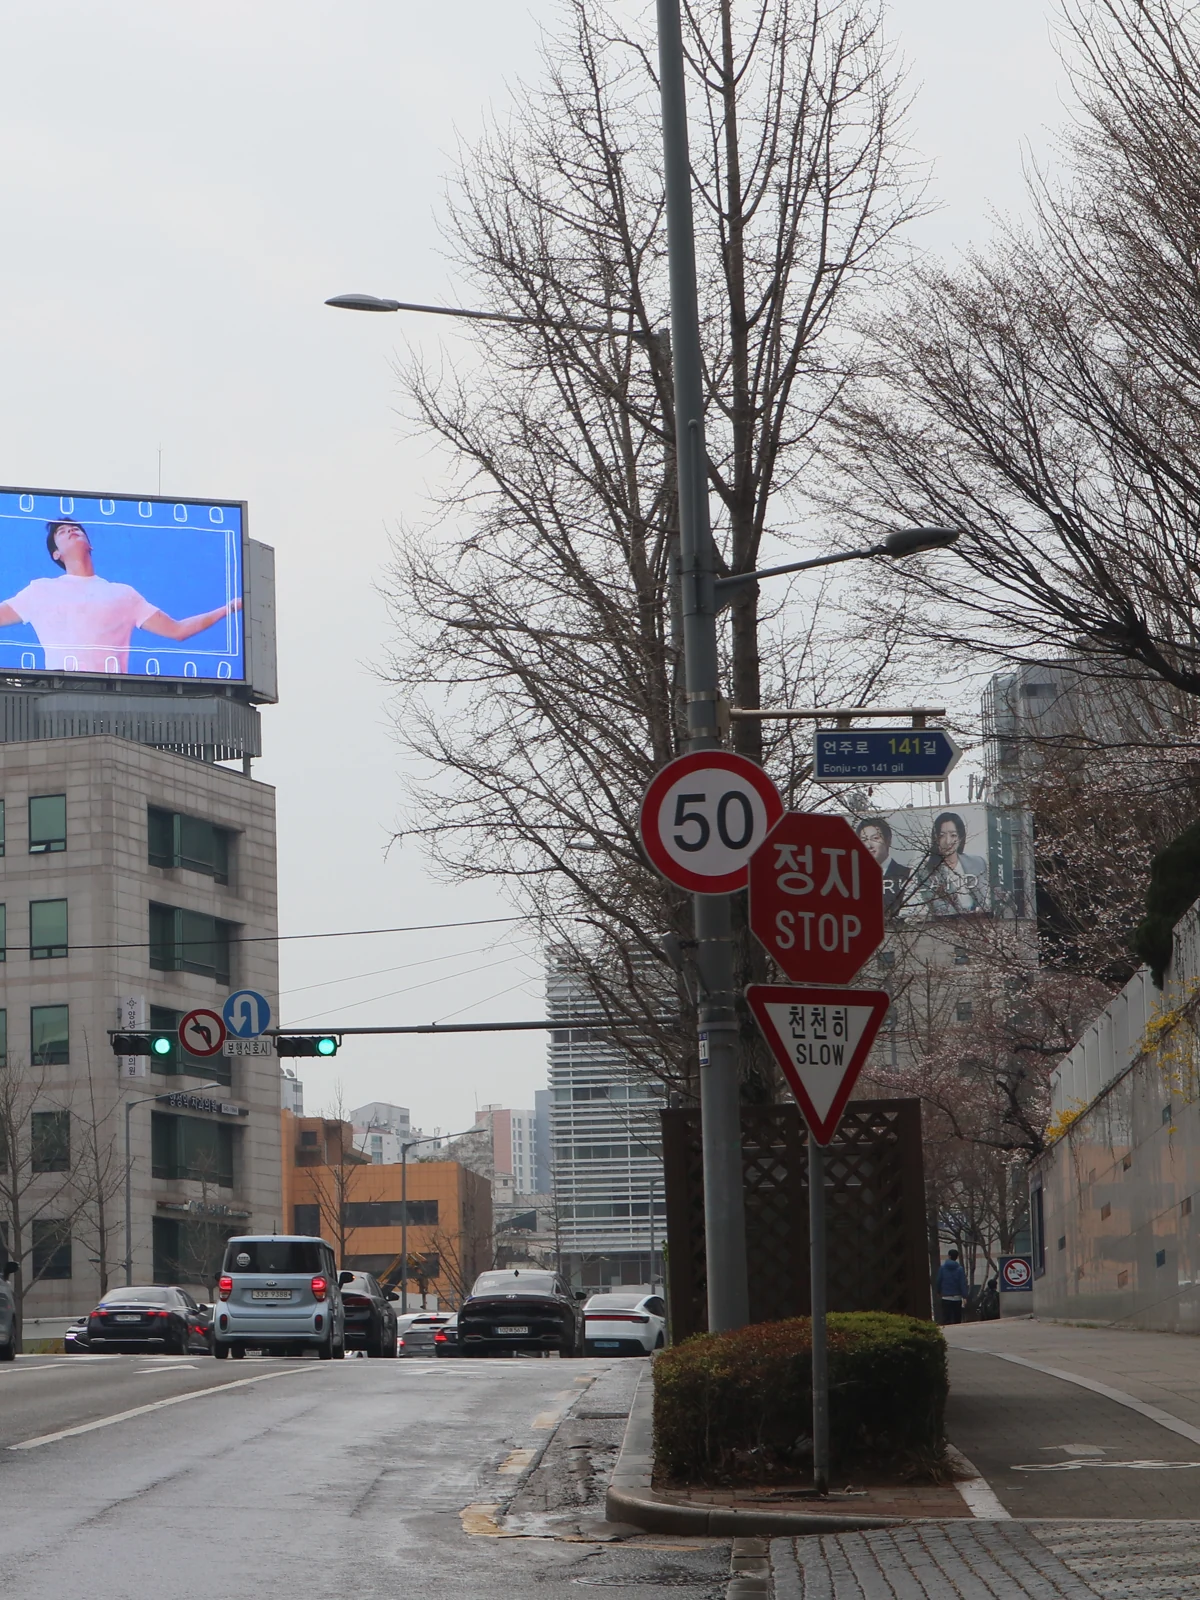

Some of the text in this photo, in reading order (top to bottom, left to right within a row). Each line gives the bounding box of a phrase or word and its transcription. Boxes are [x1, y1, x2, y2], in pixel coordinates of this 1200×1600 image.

[823, 737, 937, 755] 언주로 141길
[823, 762, 904, 774] Eonju-ro 141 gil
[672, 790, 754, 853] 50
[773, 843, 862, 901] 정지
[774, 909, 862, 954] STOP
[788, 1005, 849, 1042] 천천히
[227, 1042, 268, 1056] 보행신호시
[796, 1043, 845, 1067] SLOW
